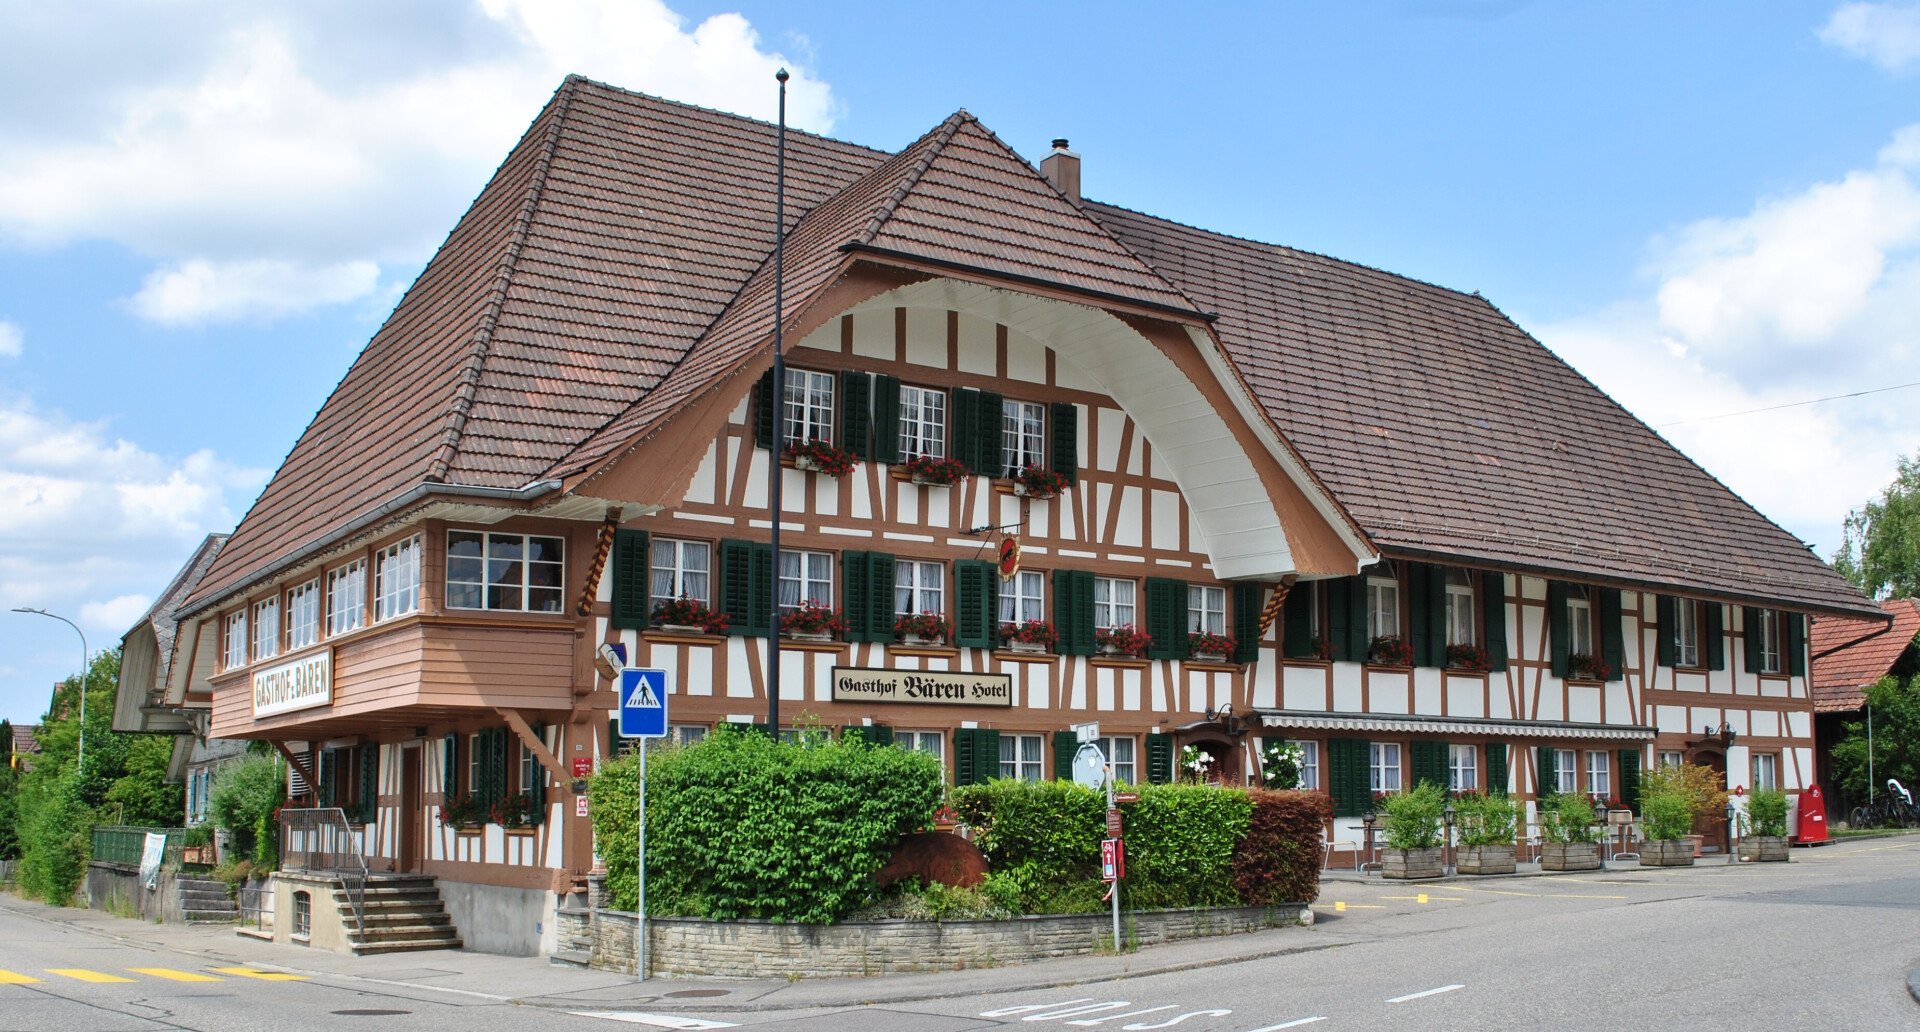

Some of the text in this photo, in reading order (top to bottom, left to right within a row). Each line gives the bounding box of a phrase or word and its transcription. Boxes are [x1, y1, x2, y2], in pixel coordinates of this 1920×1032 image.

[256, 669, 290, 707] GASTHOF
[296, 659, 327, 698] BÄREN
[839, 676, 1007, 701] Gasthof Bären Hotel
[979, 998, 1233, 1031] STOP
